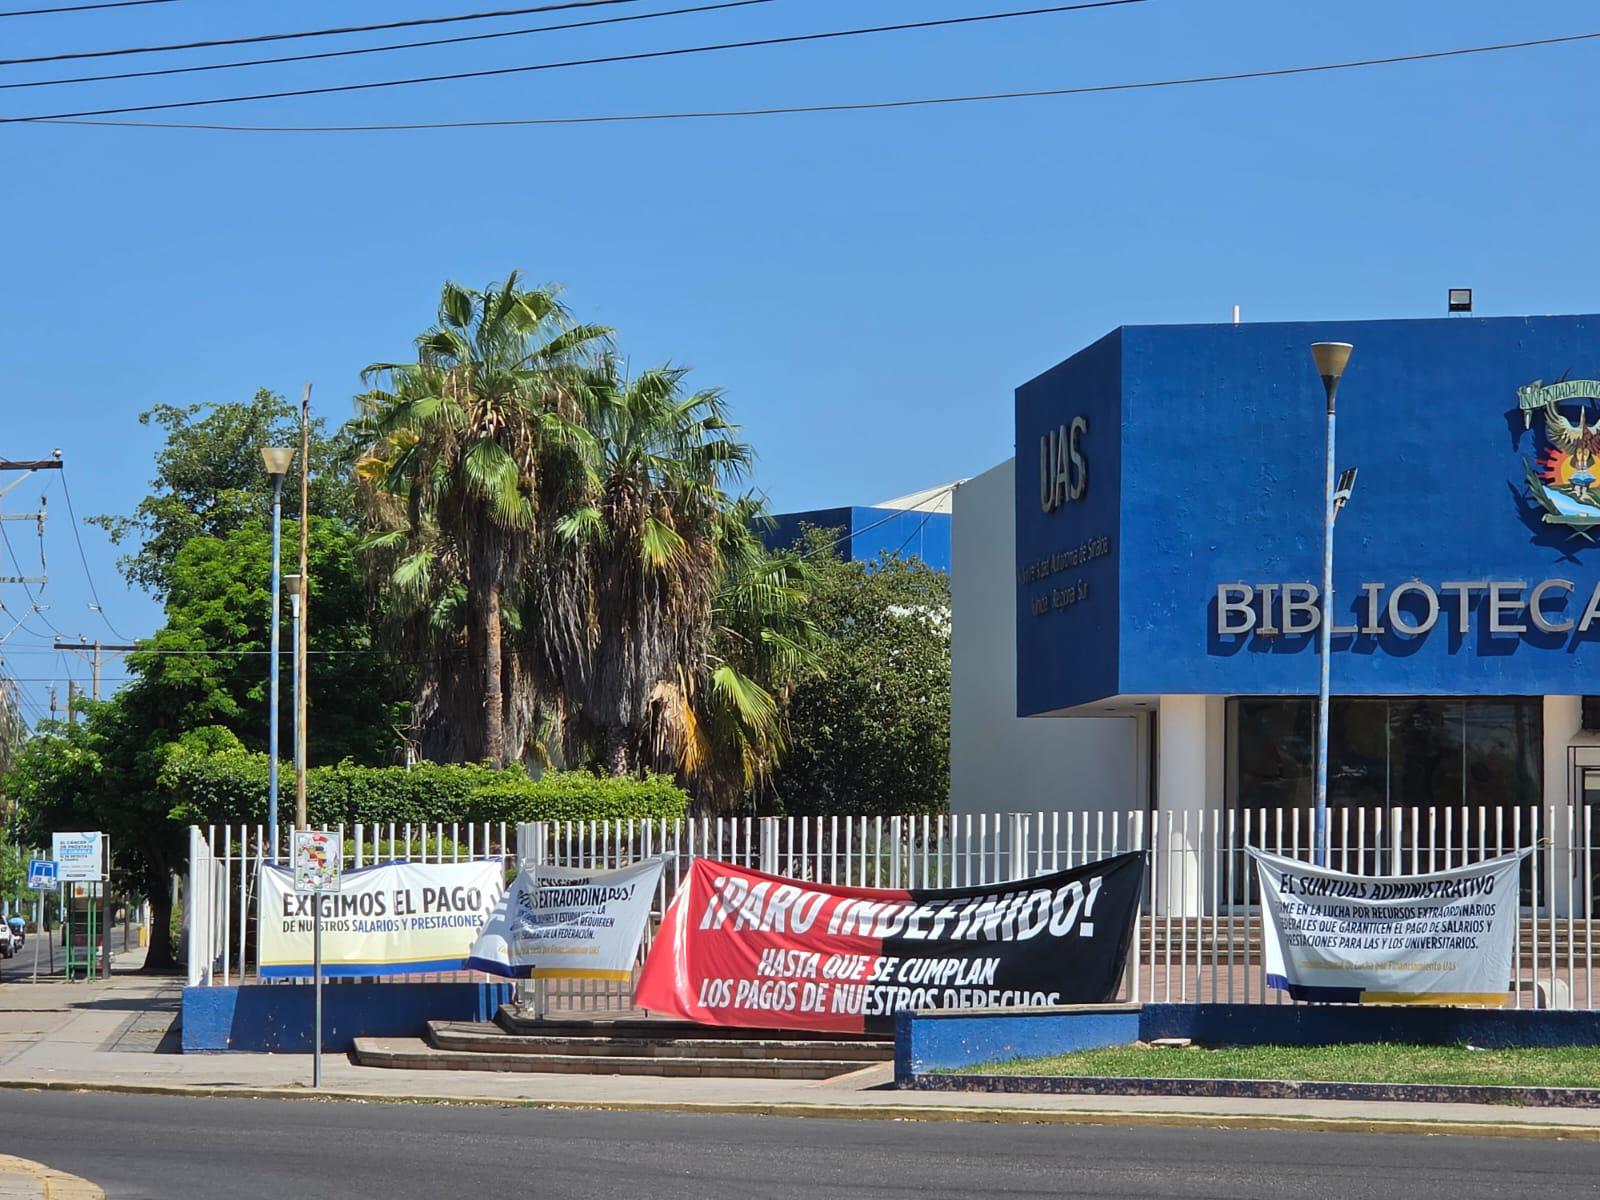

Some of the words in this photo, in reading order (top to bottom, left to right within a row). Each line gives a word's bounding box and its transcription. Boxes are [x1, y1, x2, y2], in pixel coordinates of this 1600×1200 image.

[1040, 416, 1087, 513] UAS
[1279, 873, 1296, 895] EL
[1300, 876, 1368, 899] SUNTUAS
[1369, 875, 1495, 900] ADMINISTRATIVO
[283, 890, 386, 918] EXIGIMOS
[393, 889, 416, 916] EL
[422, 886, 483, 914] PAGO
[699, 876, 831, 934] ¡PARO
[827, 876, 1103, 942] INDEFINIDO!
[1297, 903, 1309, 915] EN
[1310, 904, 1320, 917] LA
[1323, 904, 1350, 919] LUCHA
[1352, 906, 1370, 919] POR
[1371, 906, 1415, 920] RECURSOS
[1417, 903, 1496, 919] EXTRAORDINARIOS
[283, 920, 296, 933] DE
[299, 919, 350, 932] NUSTROS
[352, 919, 399, 932] SALARIOS
[401, 918, 409, 931] Y
[411, 914, 484, 930] PRESTACIONES
[1319, 920, 1337, 932] QUE
[1339, 921, 1392, 935] GARANTICEN
[1394, 922, 1402, 934] EL
[1405, 922, 1428, 934] PAGO
[1429, 921, 1440, 933] DE
[1441, 920, 1484, 933] SALARIOS
[1486, 920, 1493, 933] Y
[1339, 937, 1361, 949] PARA
[1364, 938, 1379, 949] LAS
[1381, 938, 1388, 950] Y
[1388, 937, 1403, 949] LOS
[1405, 936, 1479, 950] UNIVERSITARIOS.
[757, 948, 821, 979] HASTA
[823, 954, 870, 981] QUE
[867, 957, 900, 982] SE
[898, 957, 1000, 986] CUMPLAN
[697, 978, 734, 1008] LOS
[734, 980, 799, 1012] PAGOS
[801, 982, 829, 1013] DE
[831, 983, 938, 1016] NUESTROS
[943, 988, 1060, 1008] DERECHOS
